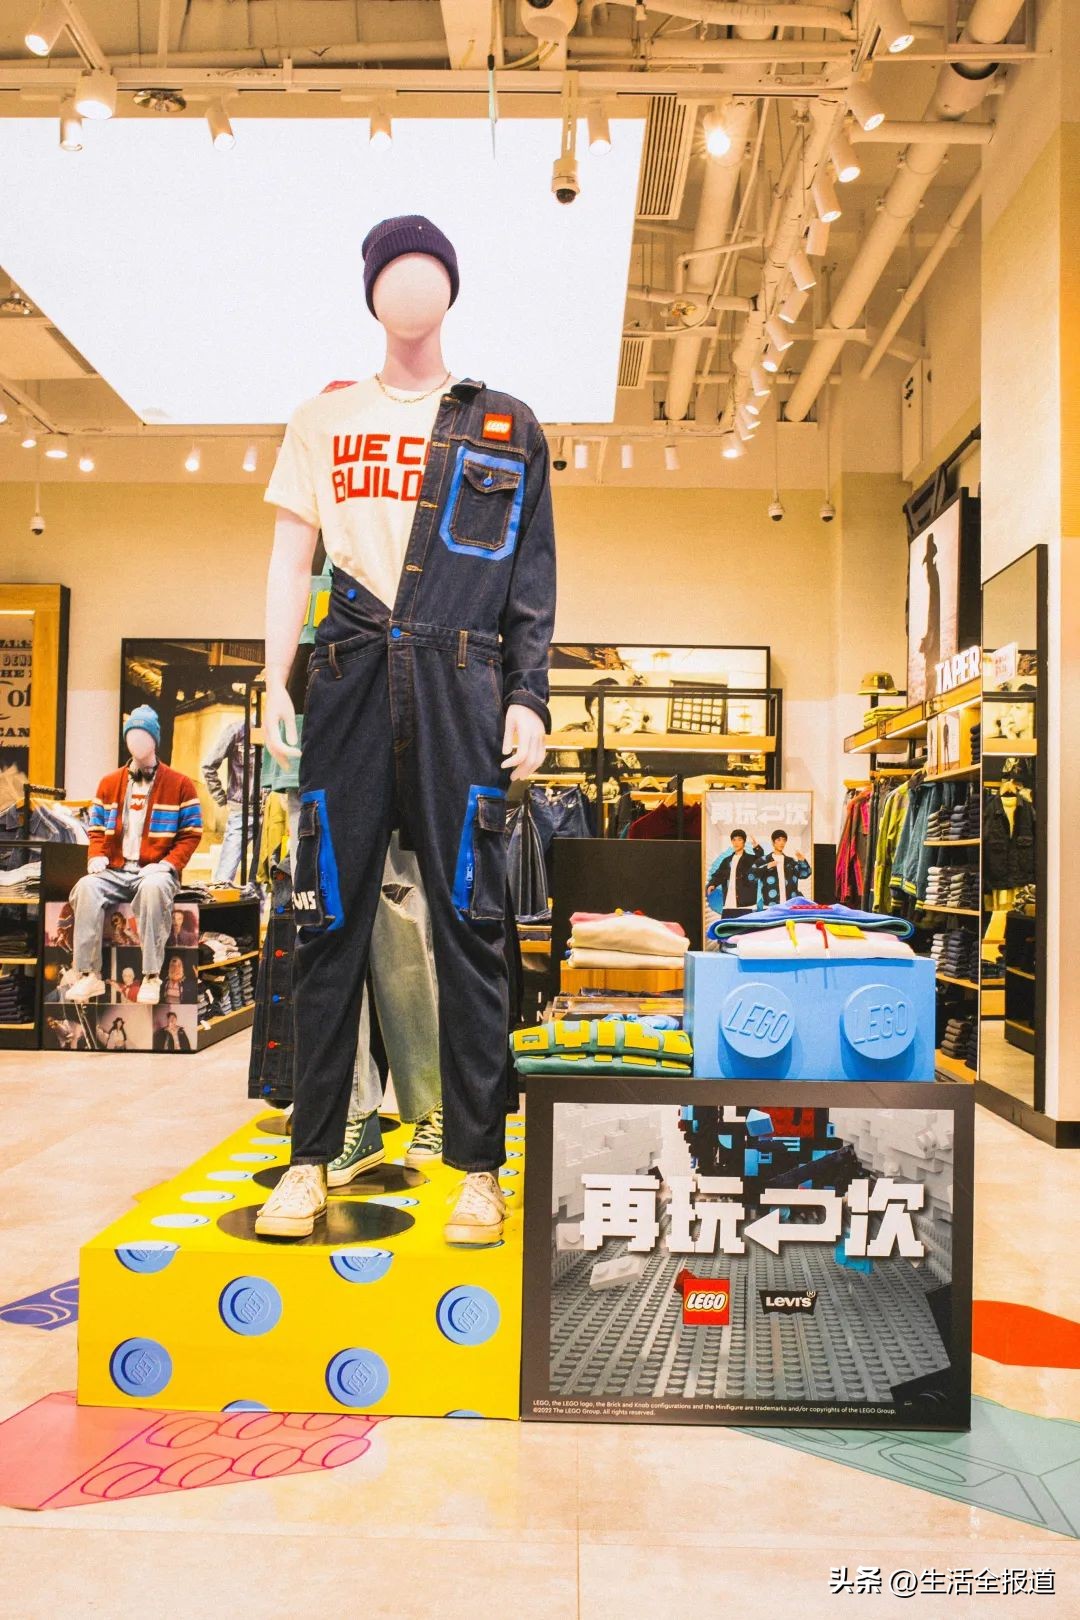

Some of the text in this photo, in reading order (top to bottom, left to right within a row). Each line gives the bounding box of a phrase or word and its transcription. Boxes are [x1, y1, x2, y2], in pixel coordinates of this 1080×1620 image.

[333, 434, 433, 466] WE C
[935, 645, 980, 696] TAPER
[724, 998, 790, 1043] LEGO
[853, 1001, 909, 1045] LEGO
[686, 1292, 728, 1311] LEGO
[650, 1402, 691, 1410] configurations
[809, 1406, 840, 1414] copyrights
